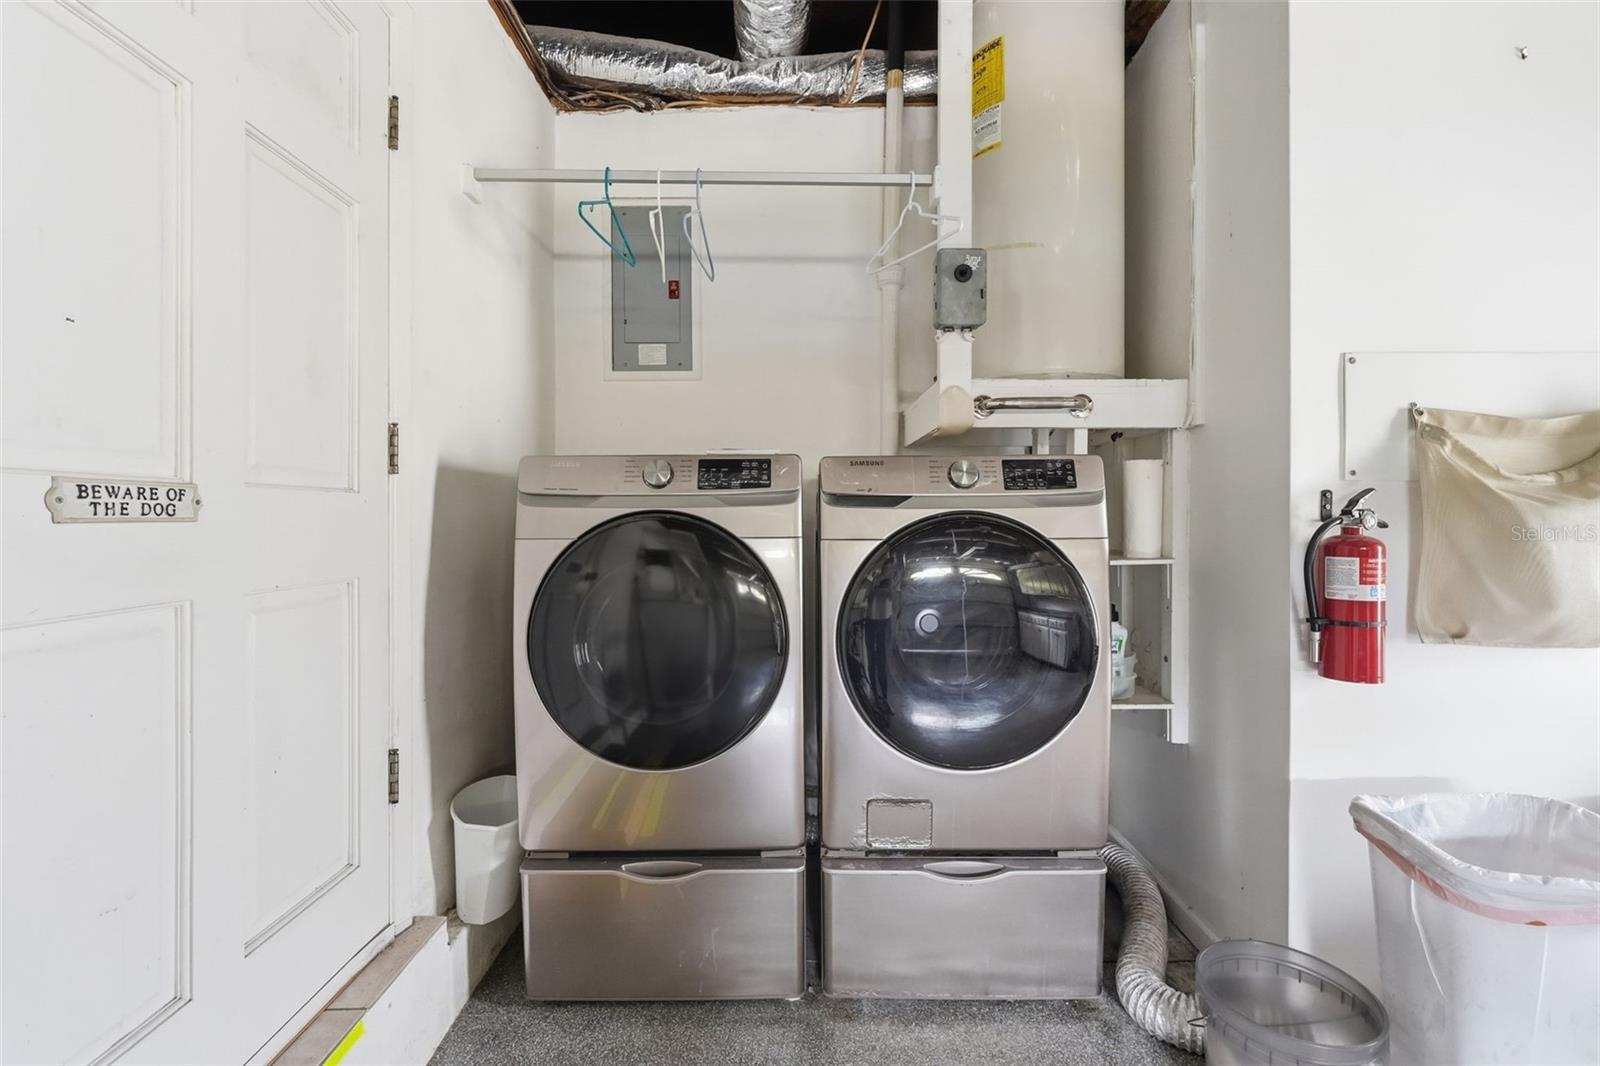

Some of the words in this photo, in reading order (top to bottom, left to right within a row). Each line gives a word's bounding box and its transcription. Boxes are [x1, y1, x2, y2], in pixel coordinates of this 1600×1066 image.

[76, 484, 159, 501] BEWARE
[166, 488, 186, 502] OF
[89, 502, 129, 516] THE
[141, 503, 176, 517] DOG
